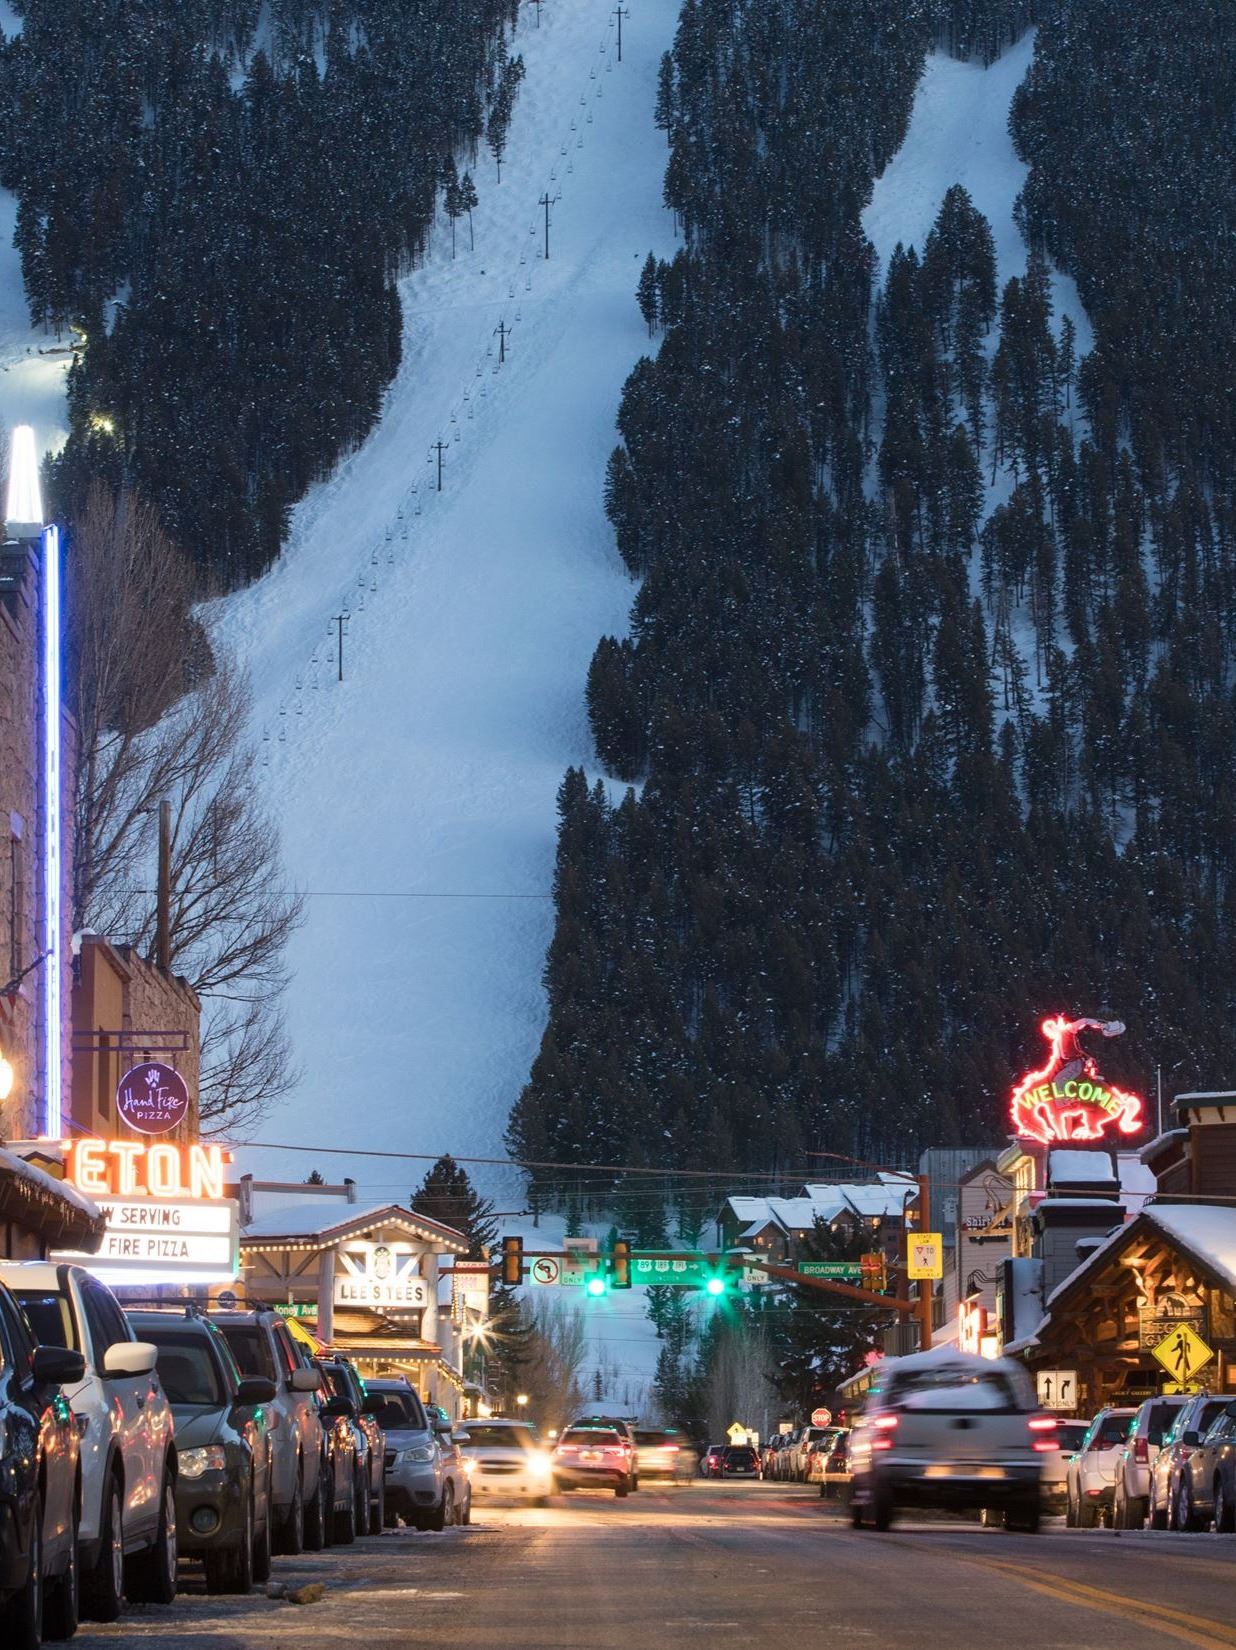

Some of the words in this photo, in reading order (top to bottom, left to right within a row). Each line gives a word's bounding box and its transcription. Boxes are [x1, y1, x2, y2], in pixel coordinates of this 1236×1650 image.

[123, 1087, 155, 1112] Hand
[1019, 1080, 1121, 1116] WELCOME
[136, 1111, 171, 1120] PIZZA
[61, 1138, 223, 1199] ETON
[120, 1207, 181, 1225] SERVING
[109, 1238, 141, 1255] FIRE
[147, 1239, 189, 1257] PIZZA
[803, 1266, 845, 1274] BROADWAY
[848, 1266, 862, 1274] AVE
[341, 1284, 381, 1299] LEES
[387, 1286, 423, 1301] TEES
